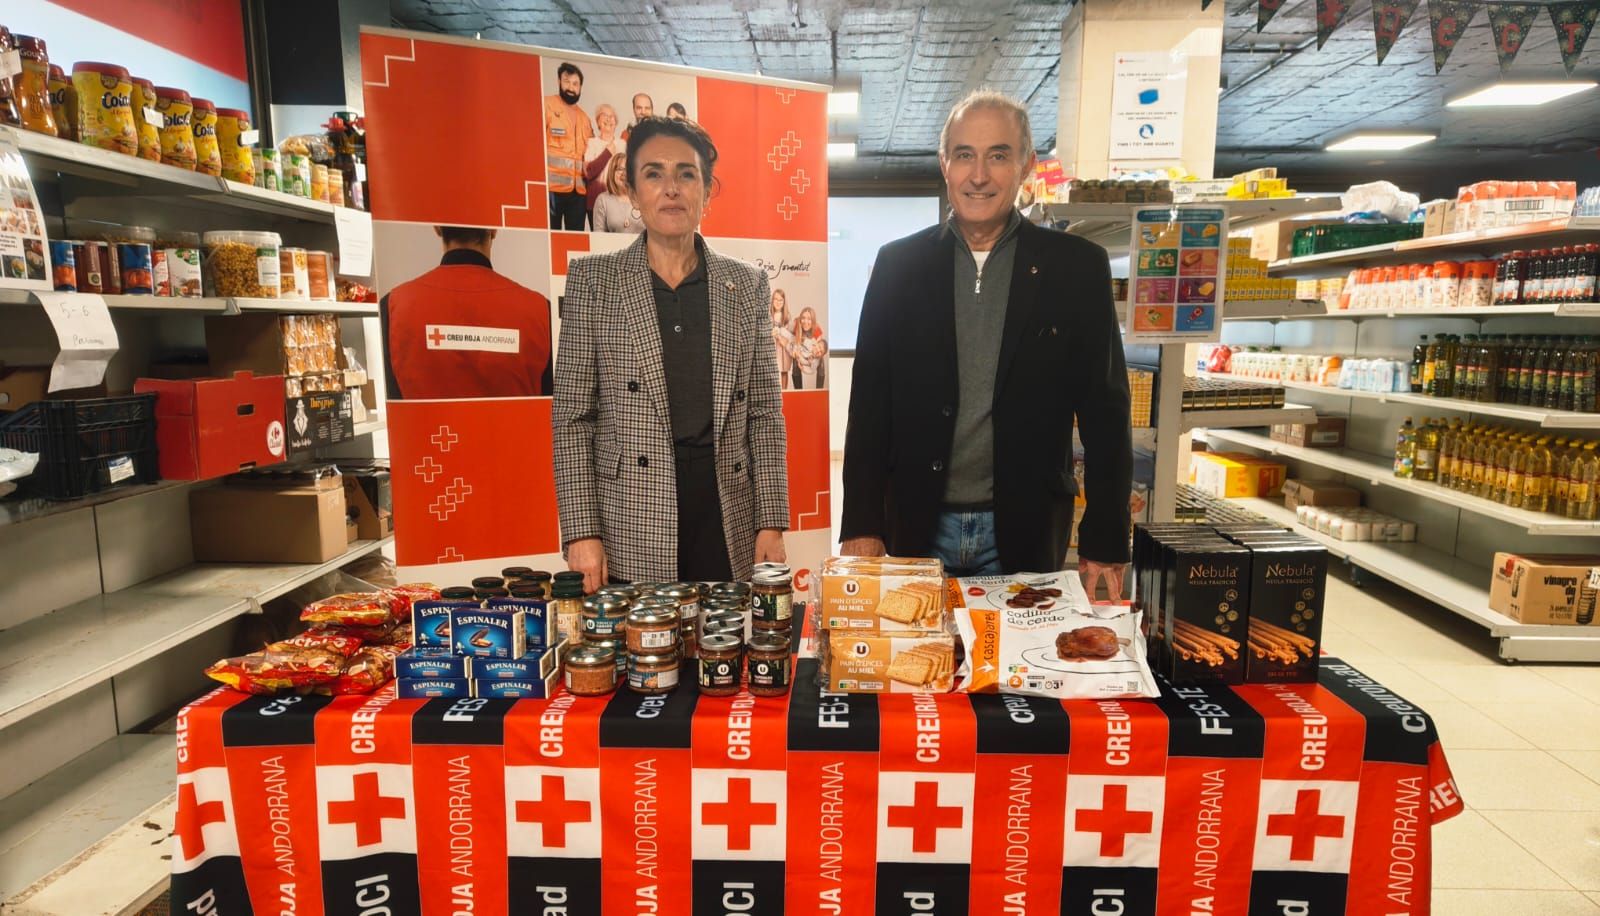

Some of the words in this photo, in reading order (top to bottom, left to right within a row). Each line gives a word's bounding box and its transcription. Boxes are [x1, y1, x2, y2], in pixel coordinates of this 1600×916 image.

[447, 333, 463, 341] CREU
[465, 334, 480, 342] ROJA
[482, 335, 516, 344] ANDORRANA
[846, 583, 856, 593] U
[1189, 563, 1237, 578] Nebula
[1265, 562, 1313, 578] Nebula
[1544, 575, 1577, 587] vinagre
[457, 616, 508, 629] ESPINALER
[984, 612, 996, 661] Cascajares
[1007, 610, 1051, 619] codillo
[1007, 617, 1024, 626] de
[1027, 615, 1065, 626] cerdo
[410, 661, 451, 670] ESPINALER
[486, 663, 527, 671] ESPINALER
[856, 645, 867, 655] U
[412, 682, 456, 690] ESPINALER
[491, 683, 532, 691] ESPINALER
[351, 707, 382, 754] CREU
[540, 708, 567, 758] CREU
[1171, 686, 1233, 735] FES-TE
[727, 711, 753, 760] CREU
[916, 713, 940, 763] CREU
[1104, 712, 1131, 766] CREU
[1300, 715, 1328, 771] CREU
[261, 756, 296, 877] ANDORRANA
[448, 755, 473, 877] ANDORRANA
[634, 758, 658, 879] ANDORRANA
[819, 761, 844, 882] ANDORRANA
[1005, 764, 1033, 886] ANDORRANA
[1193, 768, 1226, 890] ANDORRANA
[1387, 776, 1423, 905] ANDORRANA
[722, 881, 755, 916] CI
